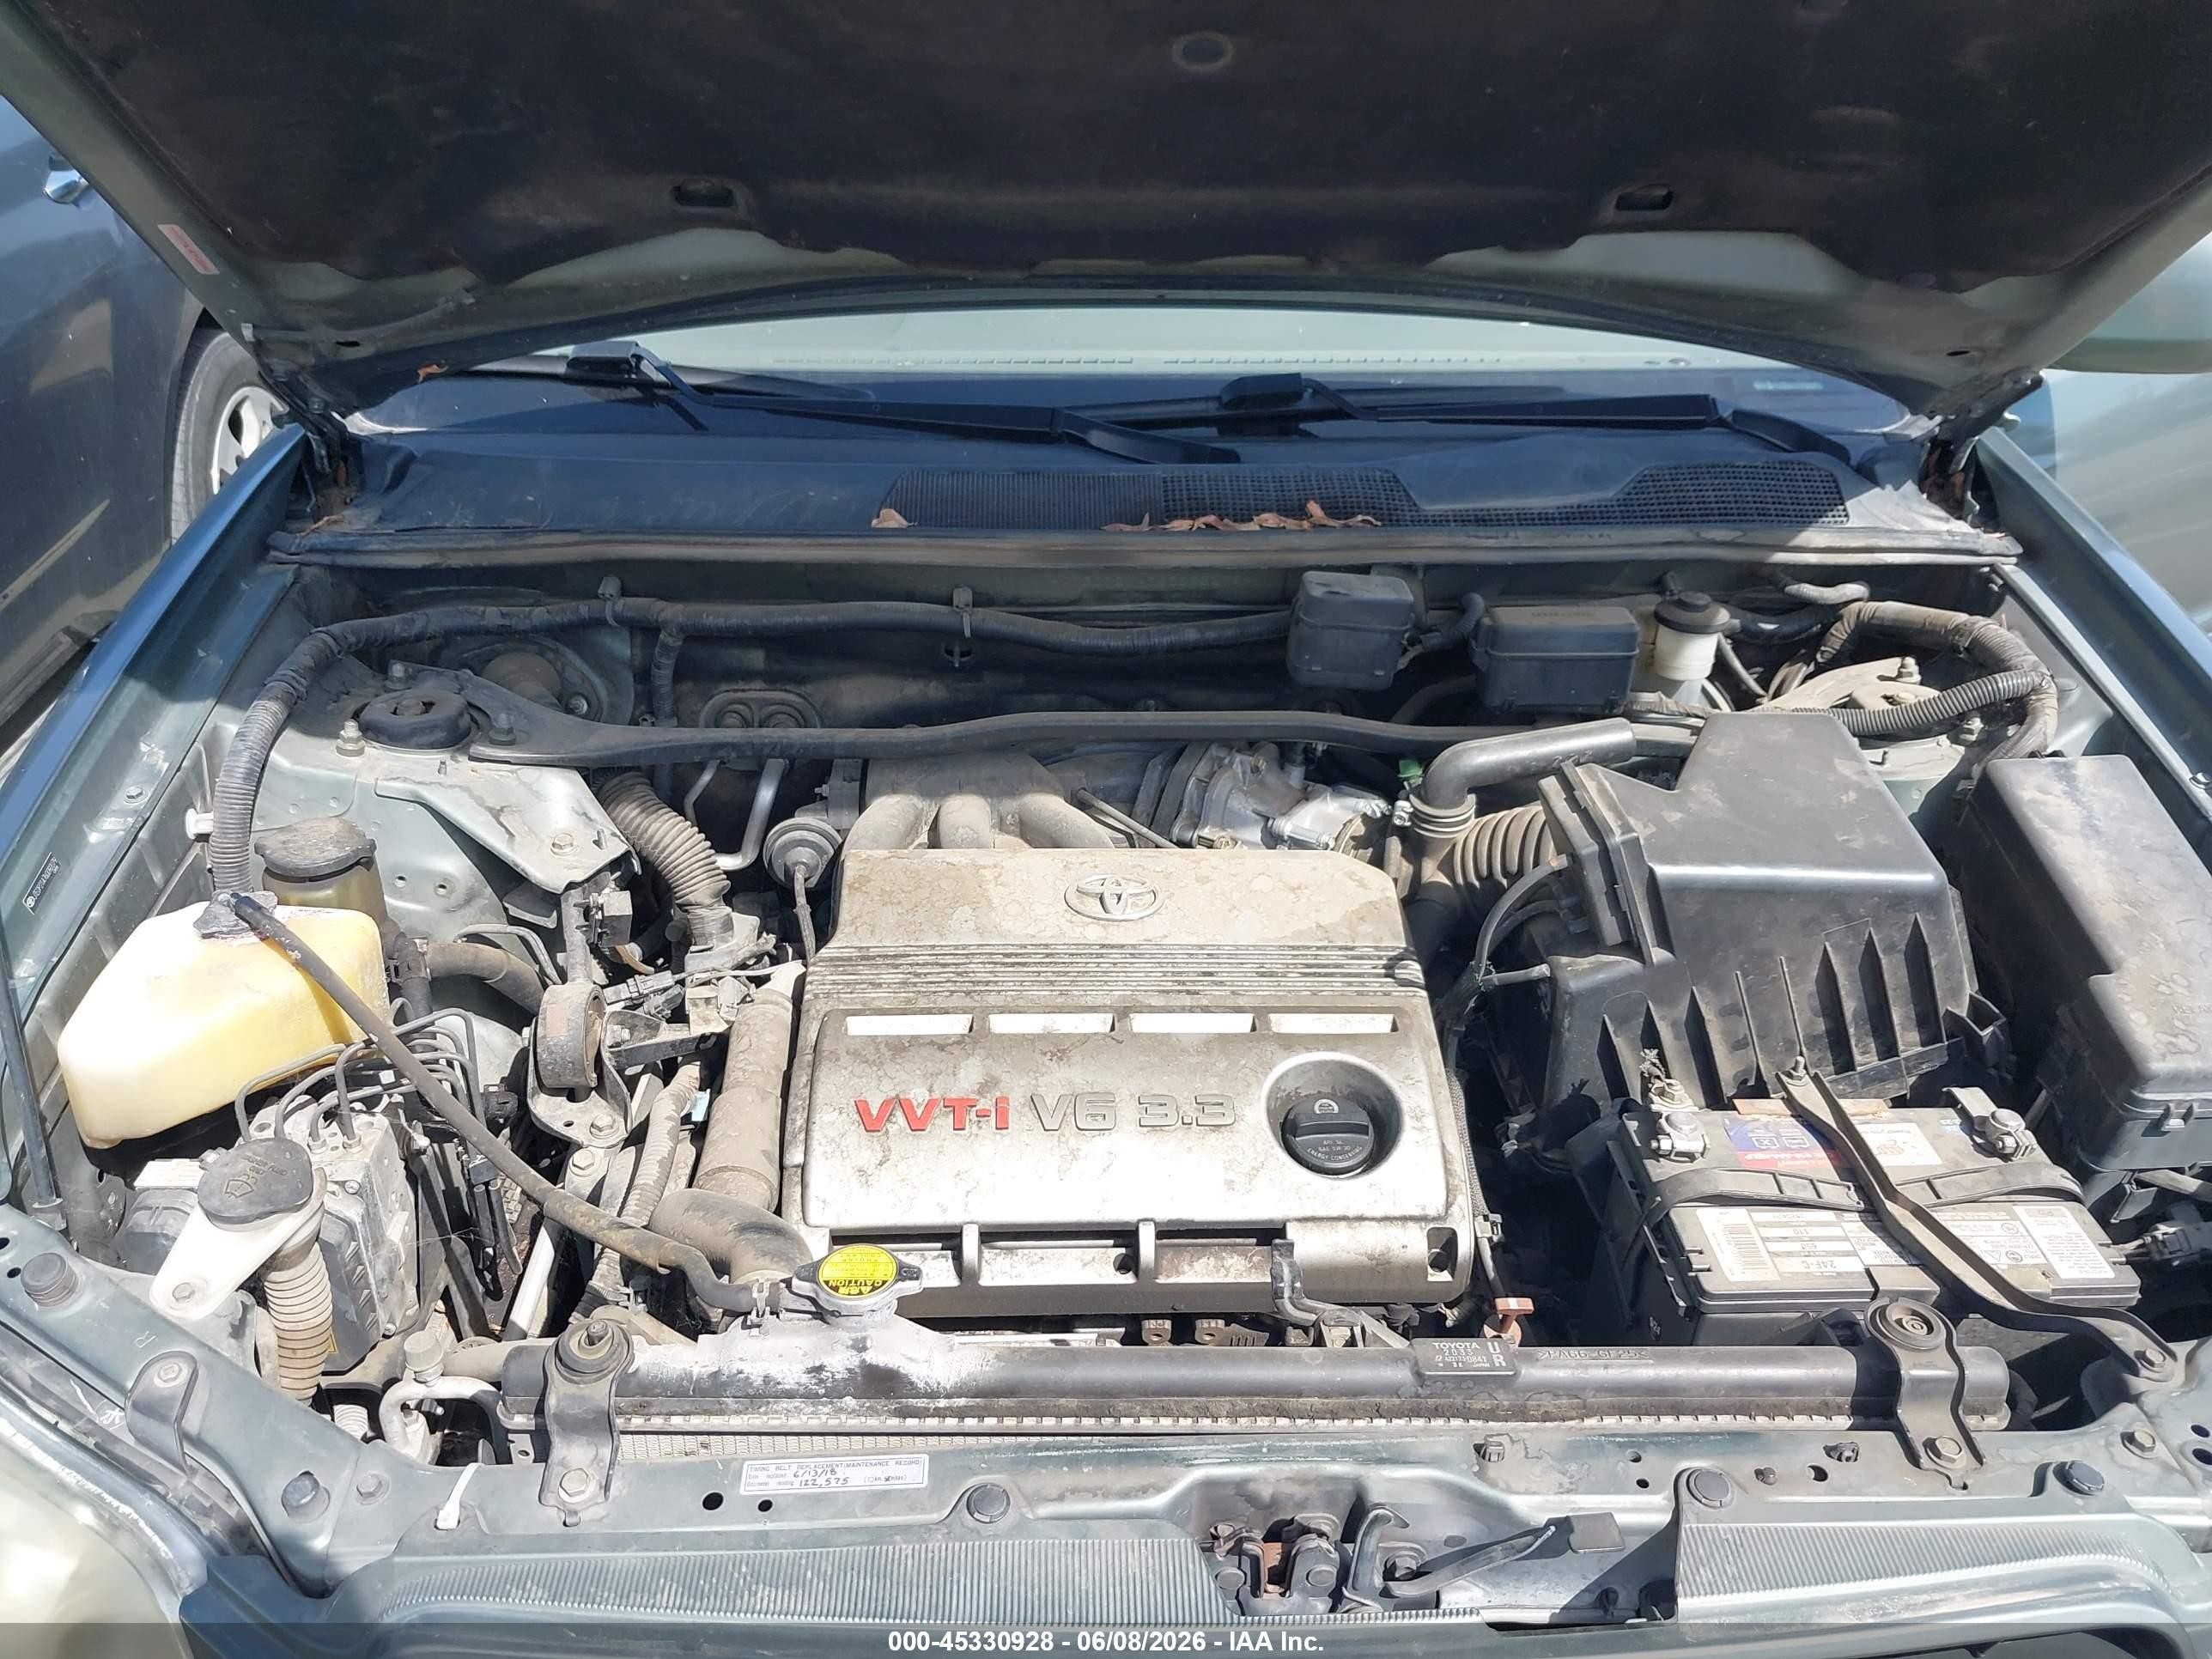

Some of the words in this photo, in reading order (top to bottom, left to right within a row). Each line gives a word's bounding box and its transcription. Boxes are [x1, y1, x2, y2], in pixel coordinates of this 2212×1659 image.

[854, 1095, 1011, 1132] VVT-i
[1031, 1092, 1117, 1132] V6
[1137, 1092, 1237, 1127] 3.3
